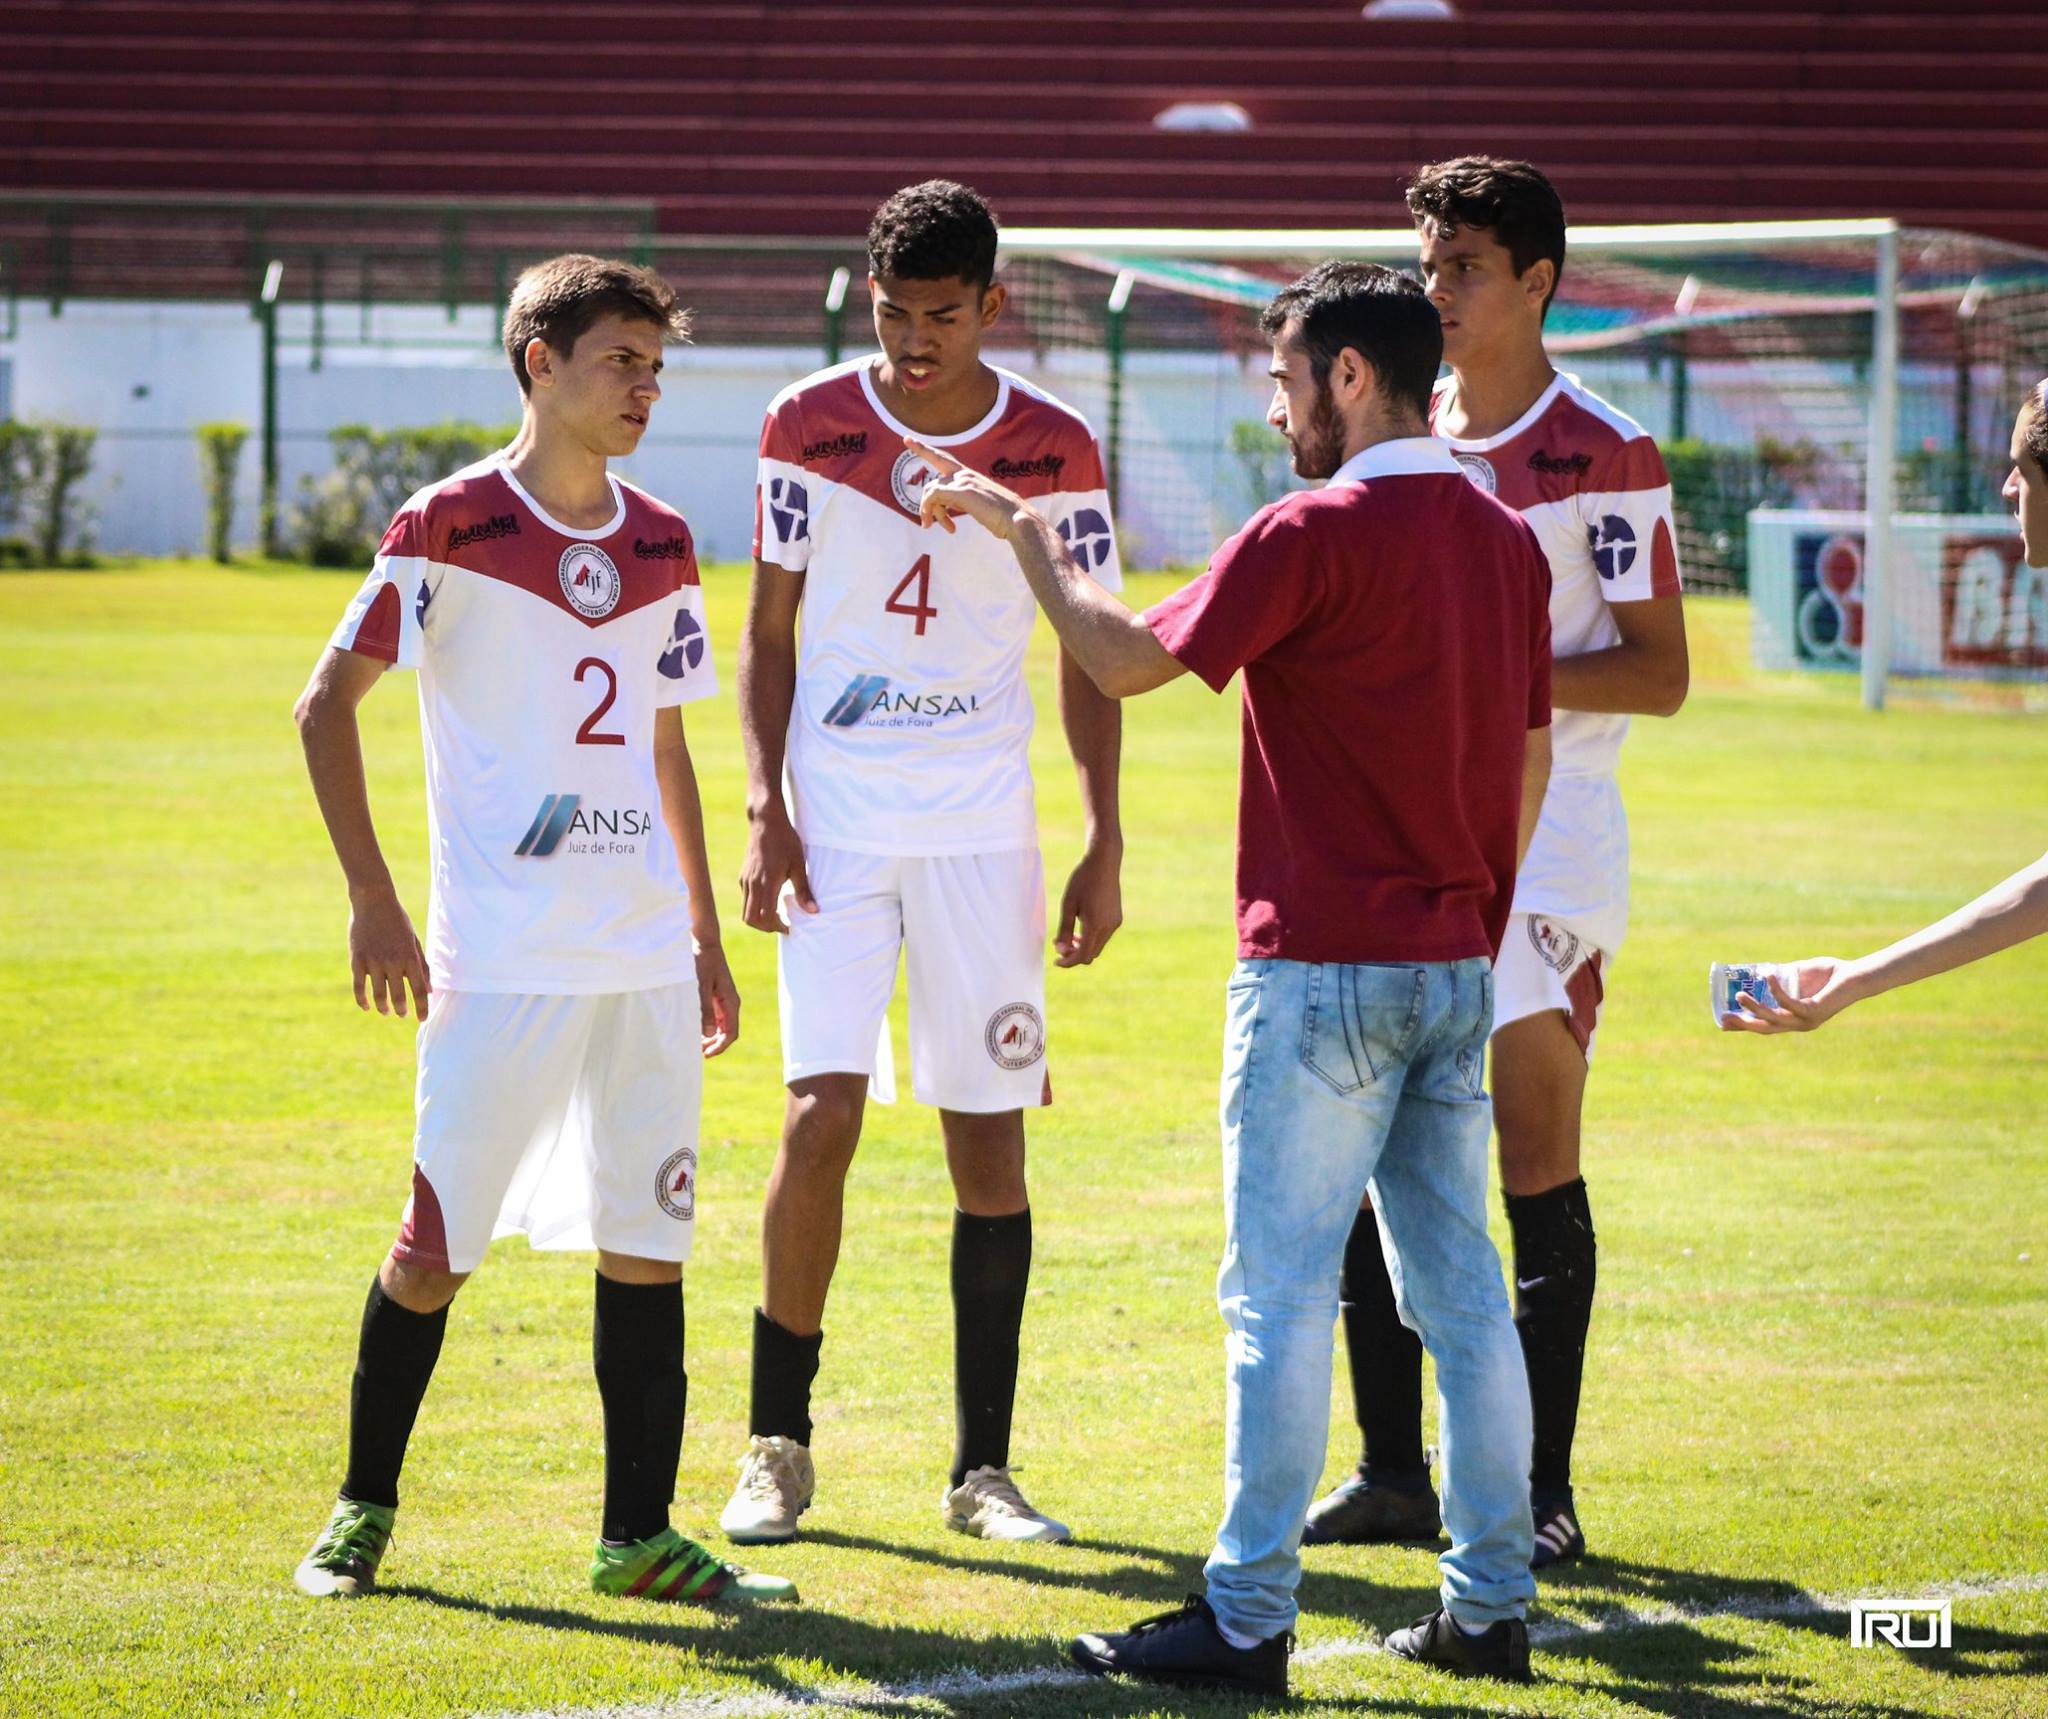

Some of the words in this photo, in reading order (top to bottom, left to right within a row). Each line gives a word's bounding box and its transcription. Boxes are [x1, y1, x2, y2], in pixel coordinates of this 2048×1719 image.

[560, 551, 572, 598] UNIVERSIDADE
[571, 545, 596, 553] FEDERAL
[596, 550, 605, 559] DE
[605, 559, 616, 571] JUIZ
[578, 605, 607, 616] FUTEBOL
[885, 553, 937, 636] 4
[573, 656, 626, 746] 2
[888, 717, 904, 727] de
[907, 717, 933, 728] Fora
[568, 842, 587, 854] Juiz
[590, 841, 605, 854] de
[609, 842, 635, 854] Fora
